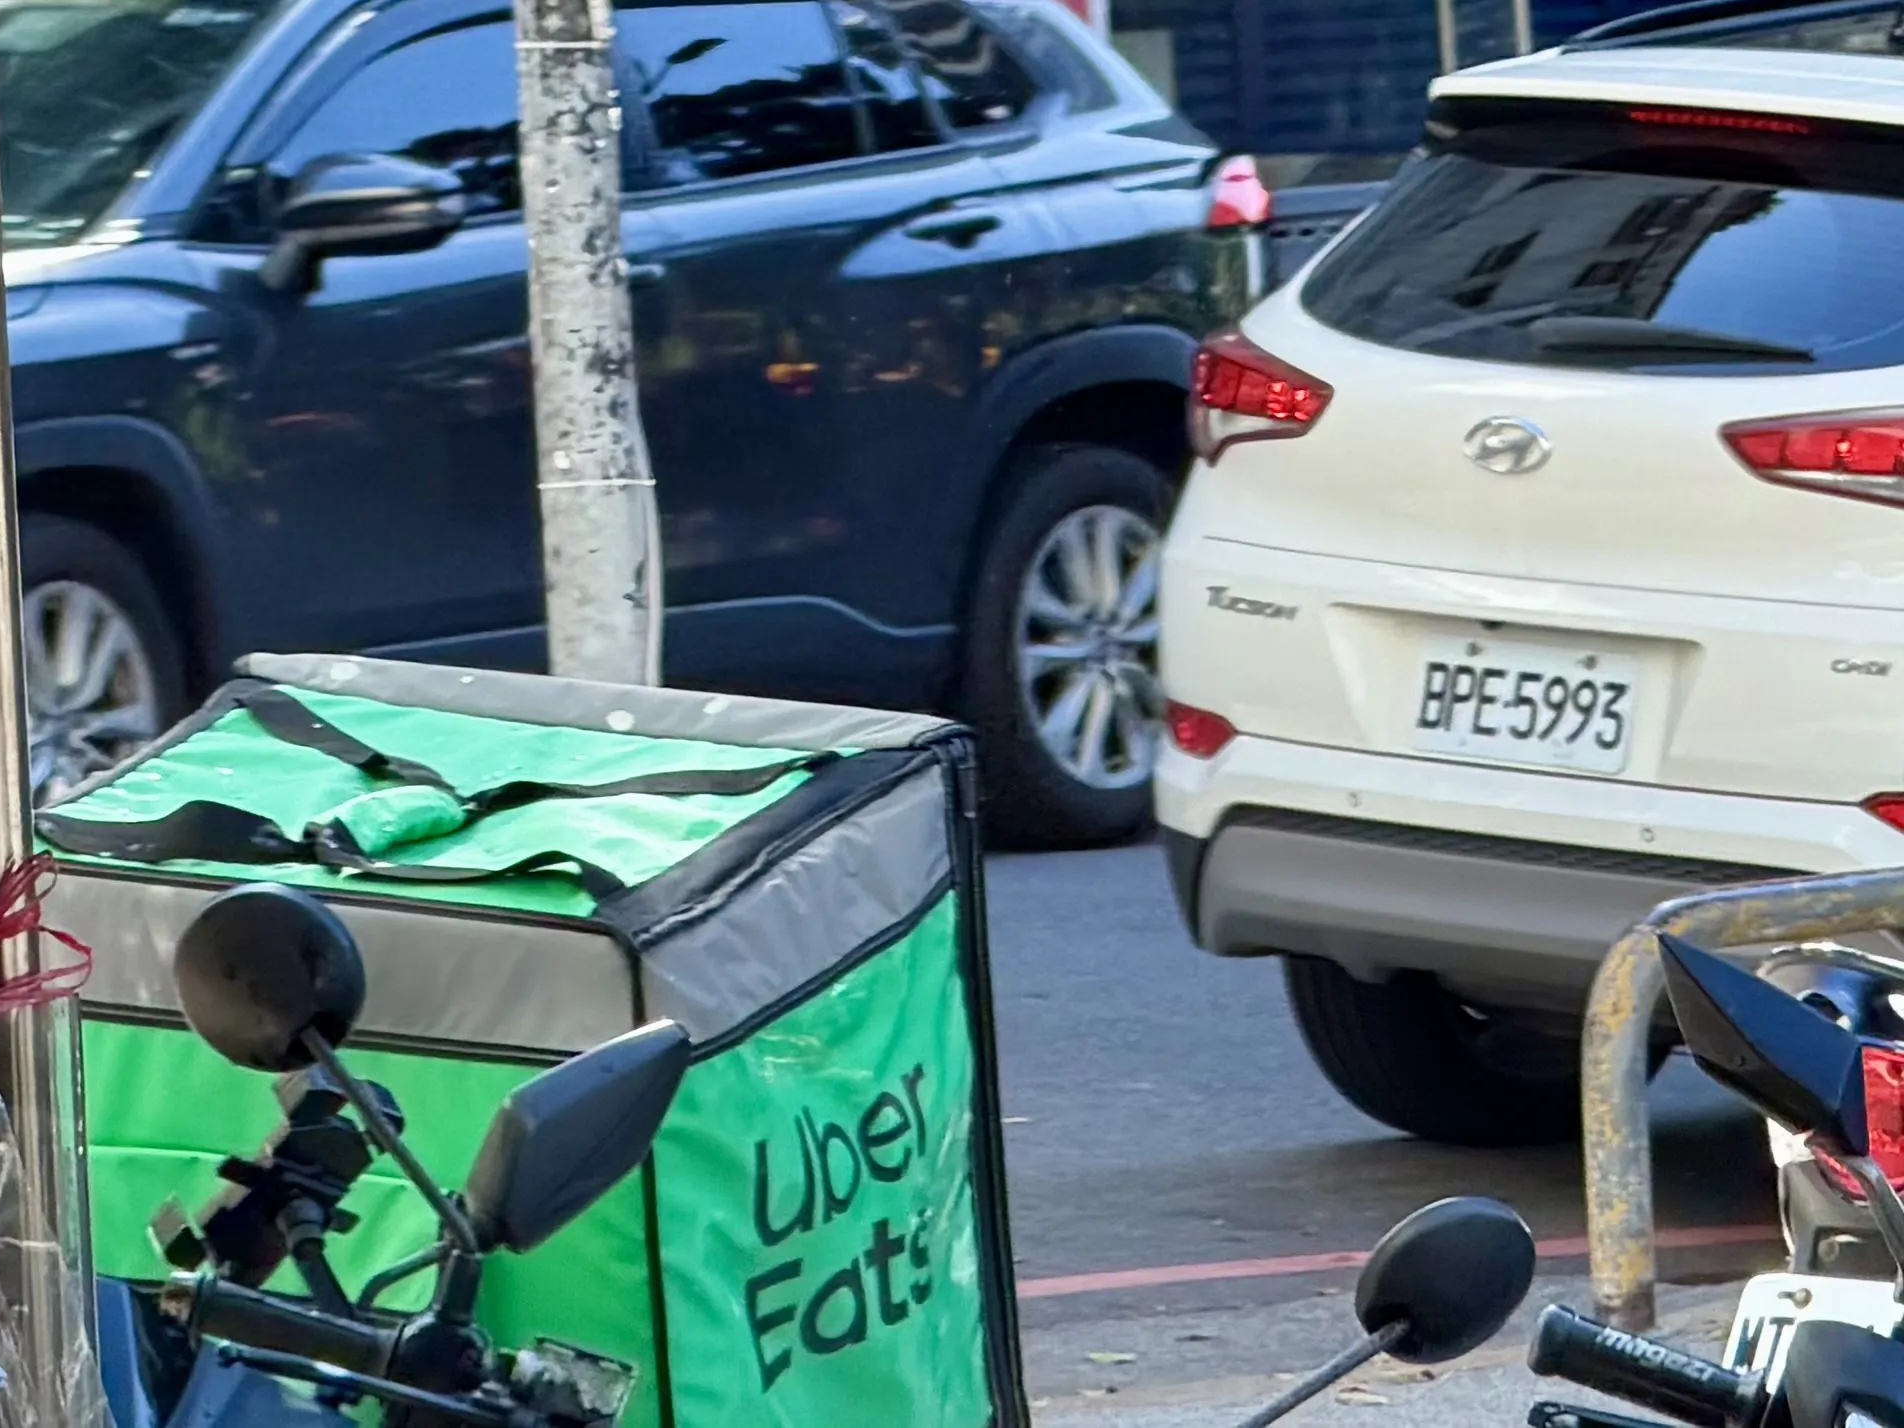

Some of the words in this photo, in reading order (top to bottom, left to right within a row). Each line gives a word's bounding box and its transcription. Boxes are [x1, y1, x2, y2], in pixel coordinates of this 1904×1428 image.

[1415, 659, 1632, 751] BPE-5993
[752, 1062, 926, 1248] Uber
[744, 1206, 933, 1394] Eats
